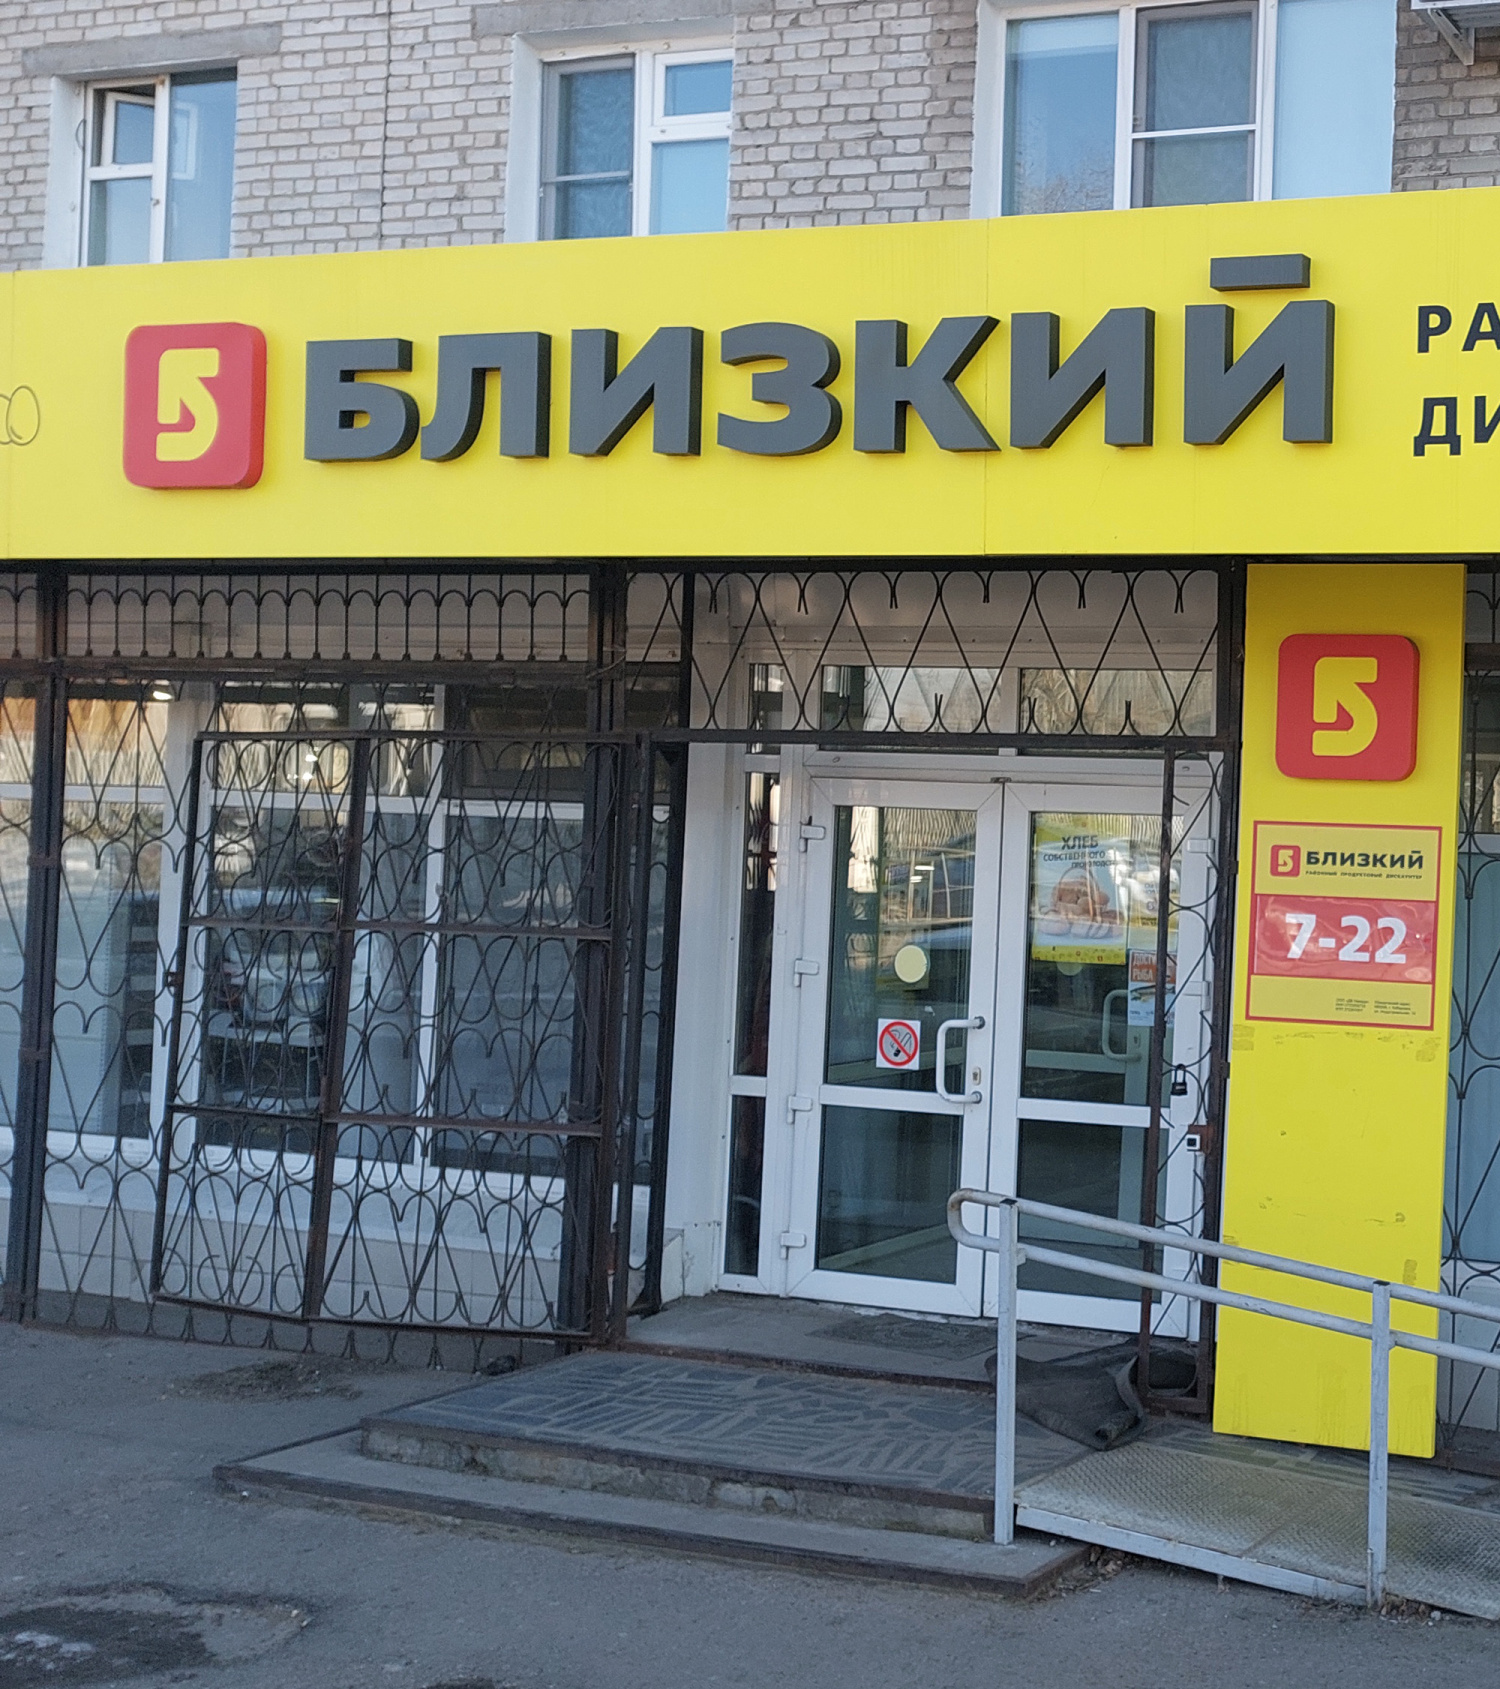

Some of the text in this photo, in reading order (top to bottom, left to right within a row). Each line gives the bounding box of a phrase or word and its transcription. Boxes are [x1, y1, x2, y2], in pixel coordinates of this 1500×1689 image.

[304, 253, 1336, 464] БЛИЗКИЙ
[1061, 835, 1099, 850] ХЛЕБ
[1306, 850, 1424, 870] БЛИЗКИЙ
[1284, 912, 1408, 964] 7-22
